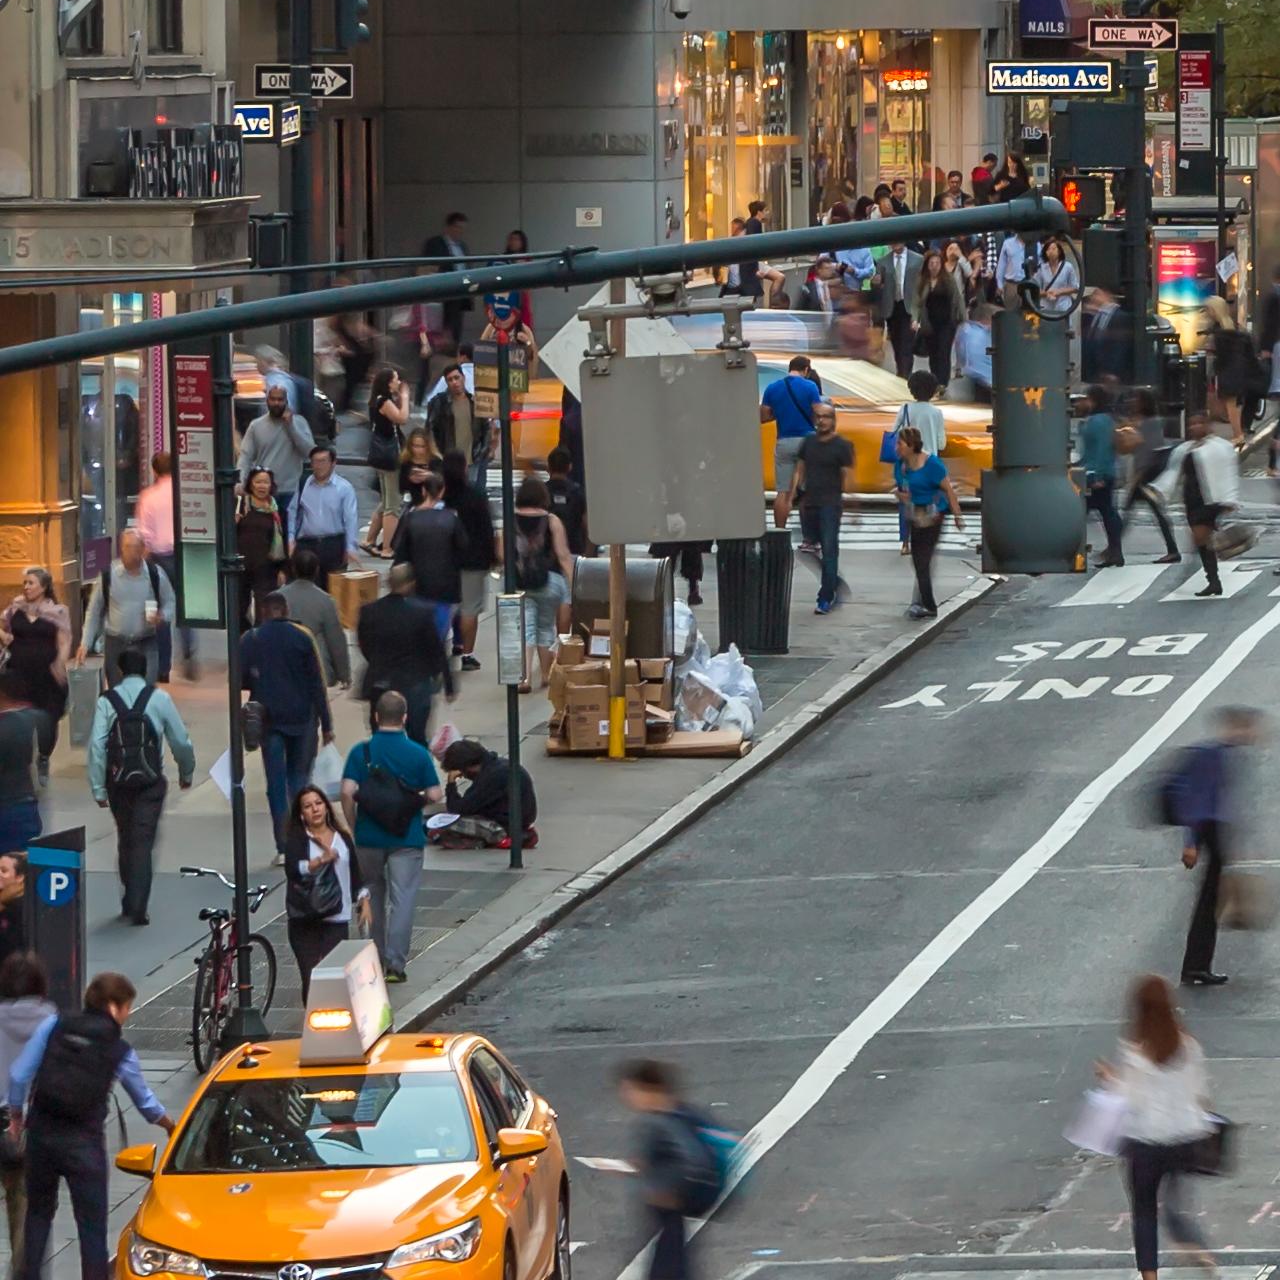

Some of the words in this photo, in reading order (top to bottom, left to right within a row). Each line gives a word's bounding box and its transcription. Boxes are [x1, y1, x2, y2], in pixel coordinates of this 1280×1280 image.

[1028, 22, 1065, 33] NAILS
[1102, 28, 1126, 40] ONE
[1138, 28, 1164, 40] WAY
[268, 75, 290, 88] ON
[992, 70, 1070, 87] Madison
[1074, 70, 1109, 87] Ave
[50, 872, 69, 900] P
